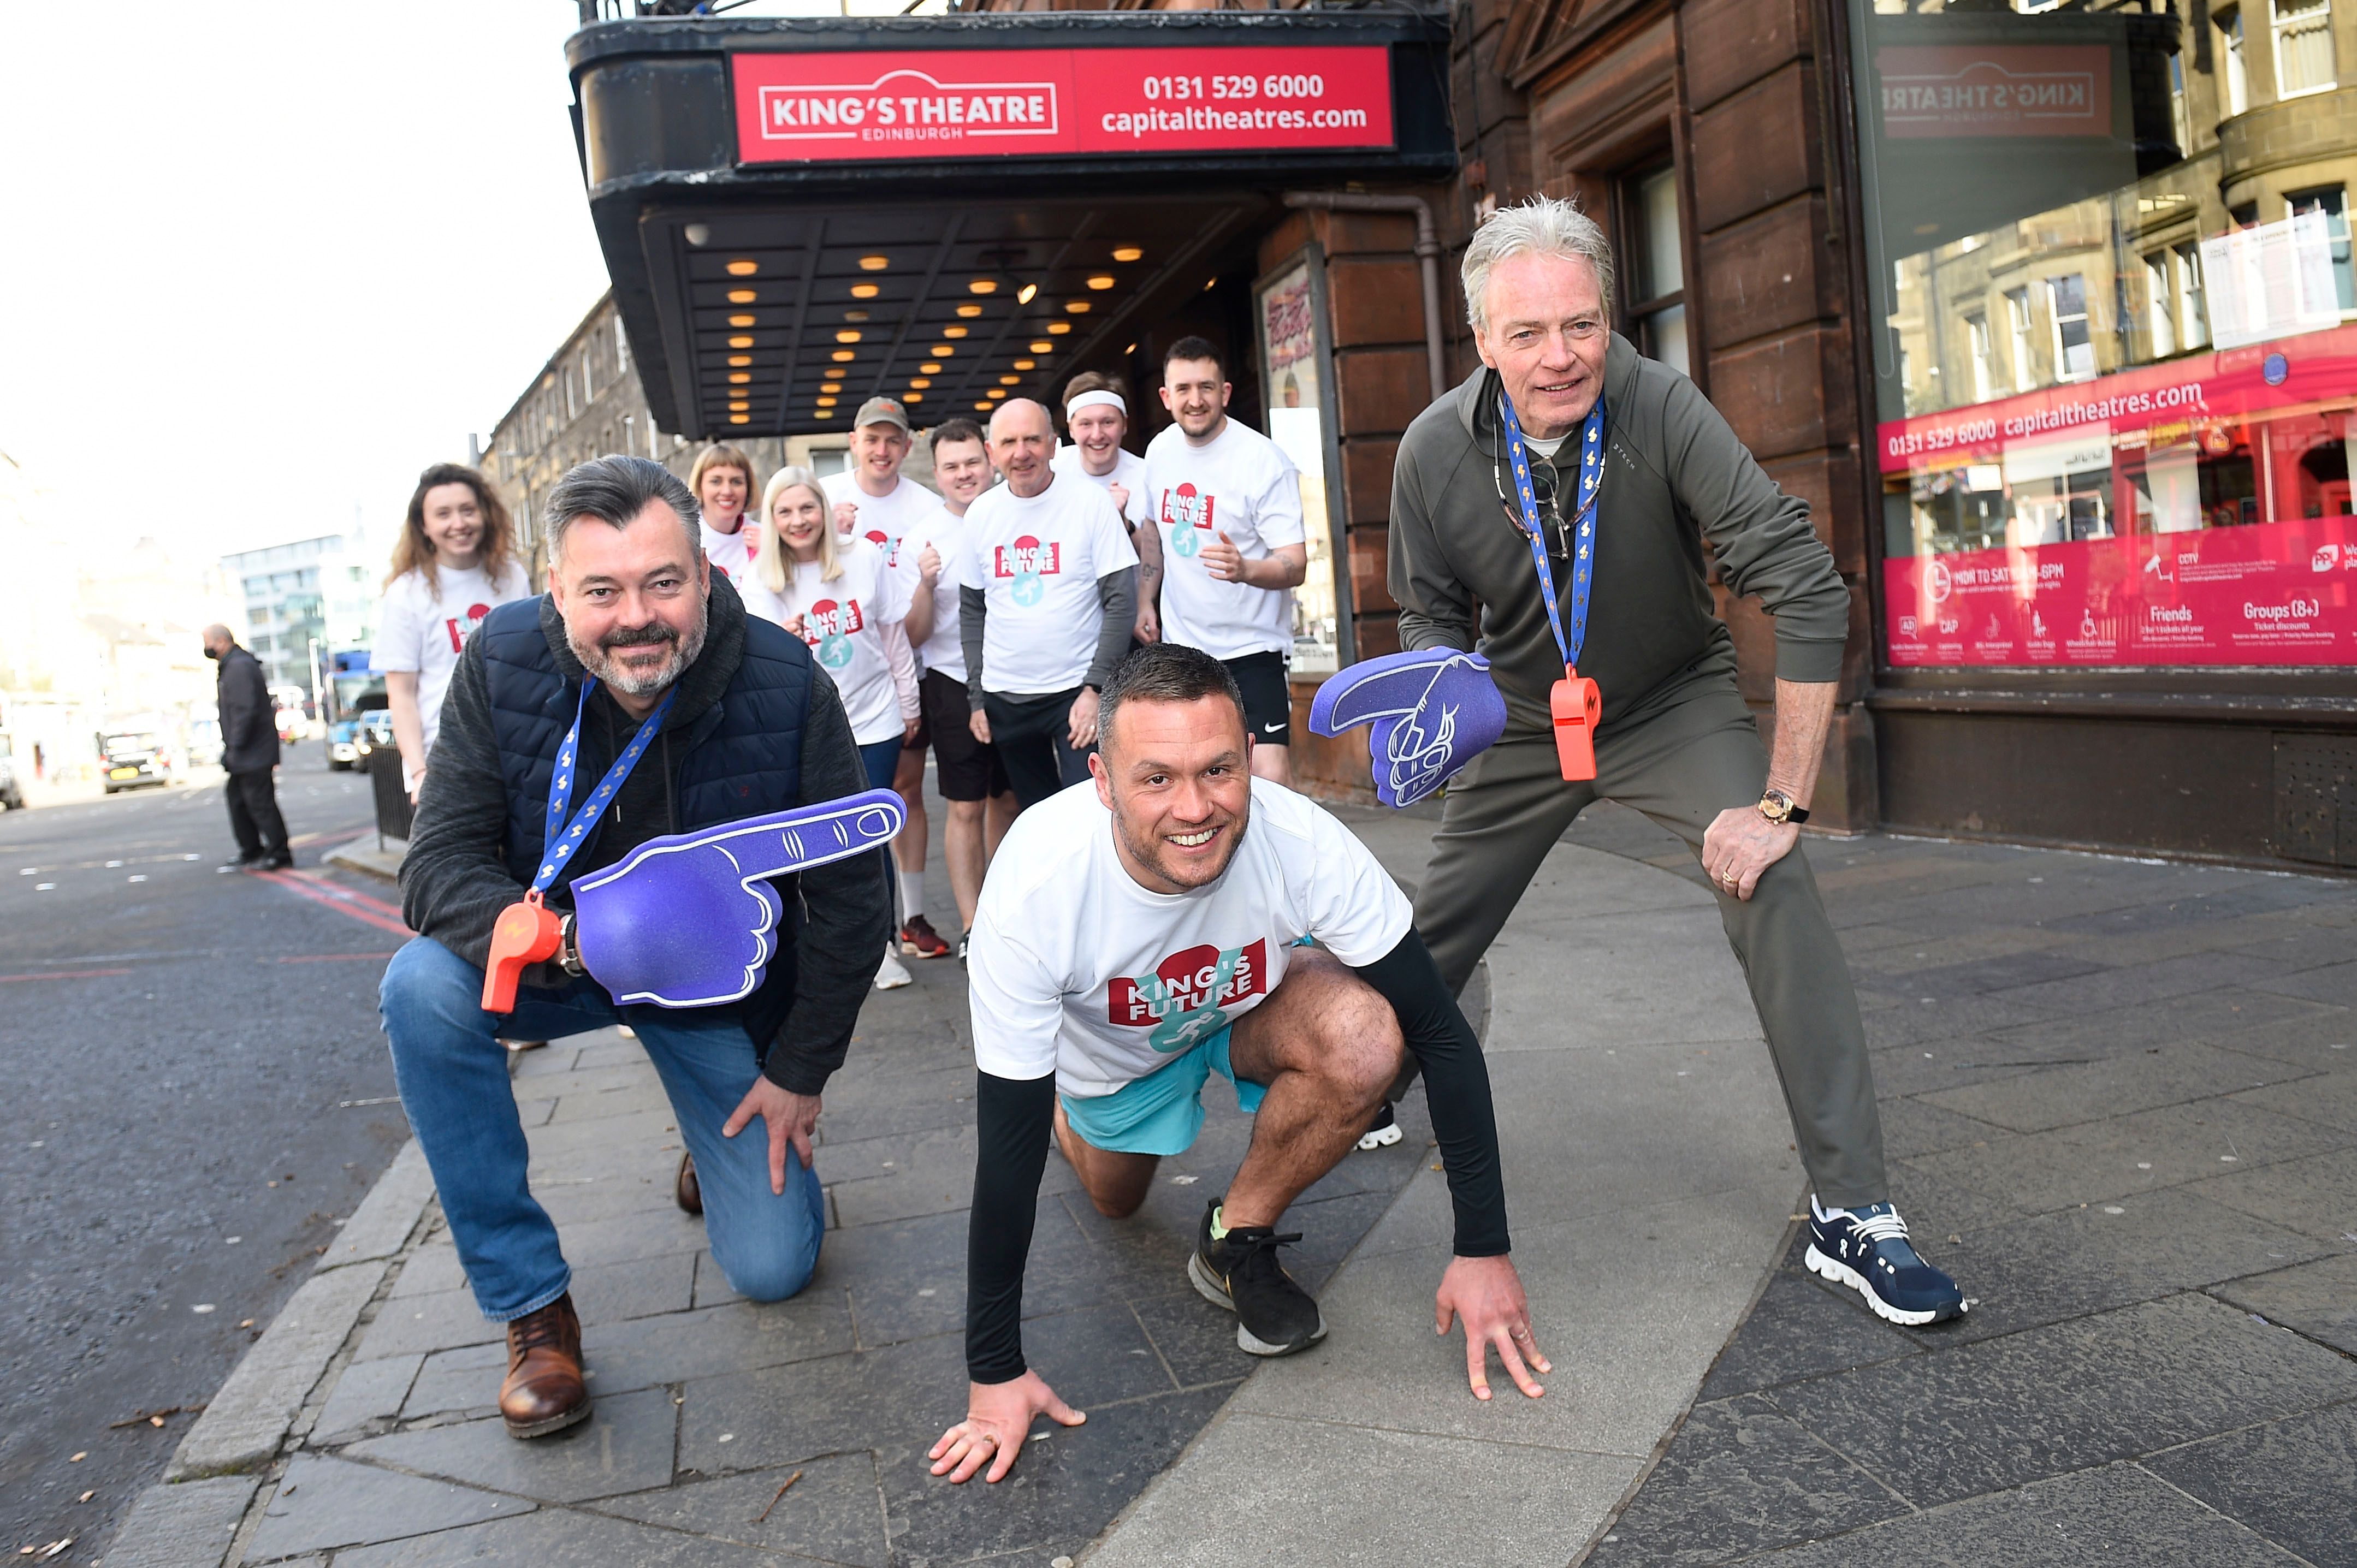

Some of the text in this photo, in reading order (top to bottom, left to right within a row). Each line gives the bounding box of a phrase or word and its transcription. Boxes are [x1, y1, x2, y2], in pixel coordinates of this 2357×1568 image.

[1143, 74, 1324, 100] 0131 529 6000
[772, 95, 1045, 126] KING'S THEATRE
[1101, 105, 1367, 138] capitaltheatres.com
[862, 127, 963, 141] EDINBURGH
[1888, 432, 1923, 457] 0131
[1926, 426, 1955, 450] 529
[1957, 418, 1997, 444] 6000
[2003, 382, 2203, 438] capitaltheatres.com
[1164, 506, 1208, 525] FUTURE
[1000, 557, 1055, 574] FUTURE
[2178, 553, 2199, 565] CCTV
[1955, 569, 1976, 586] MON
[1977, 568, 1990, 584] TO
[1991, 567, 2009, 583] SAT
[2150, 603, 2193, 622] Friends
[2244, 598, 2319, 622] Groups (8+)
[1128, 955, 1251, 1005] KING'S
[1129, 973, 1253, 1020] FUTURE
